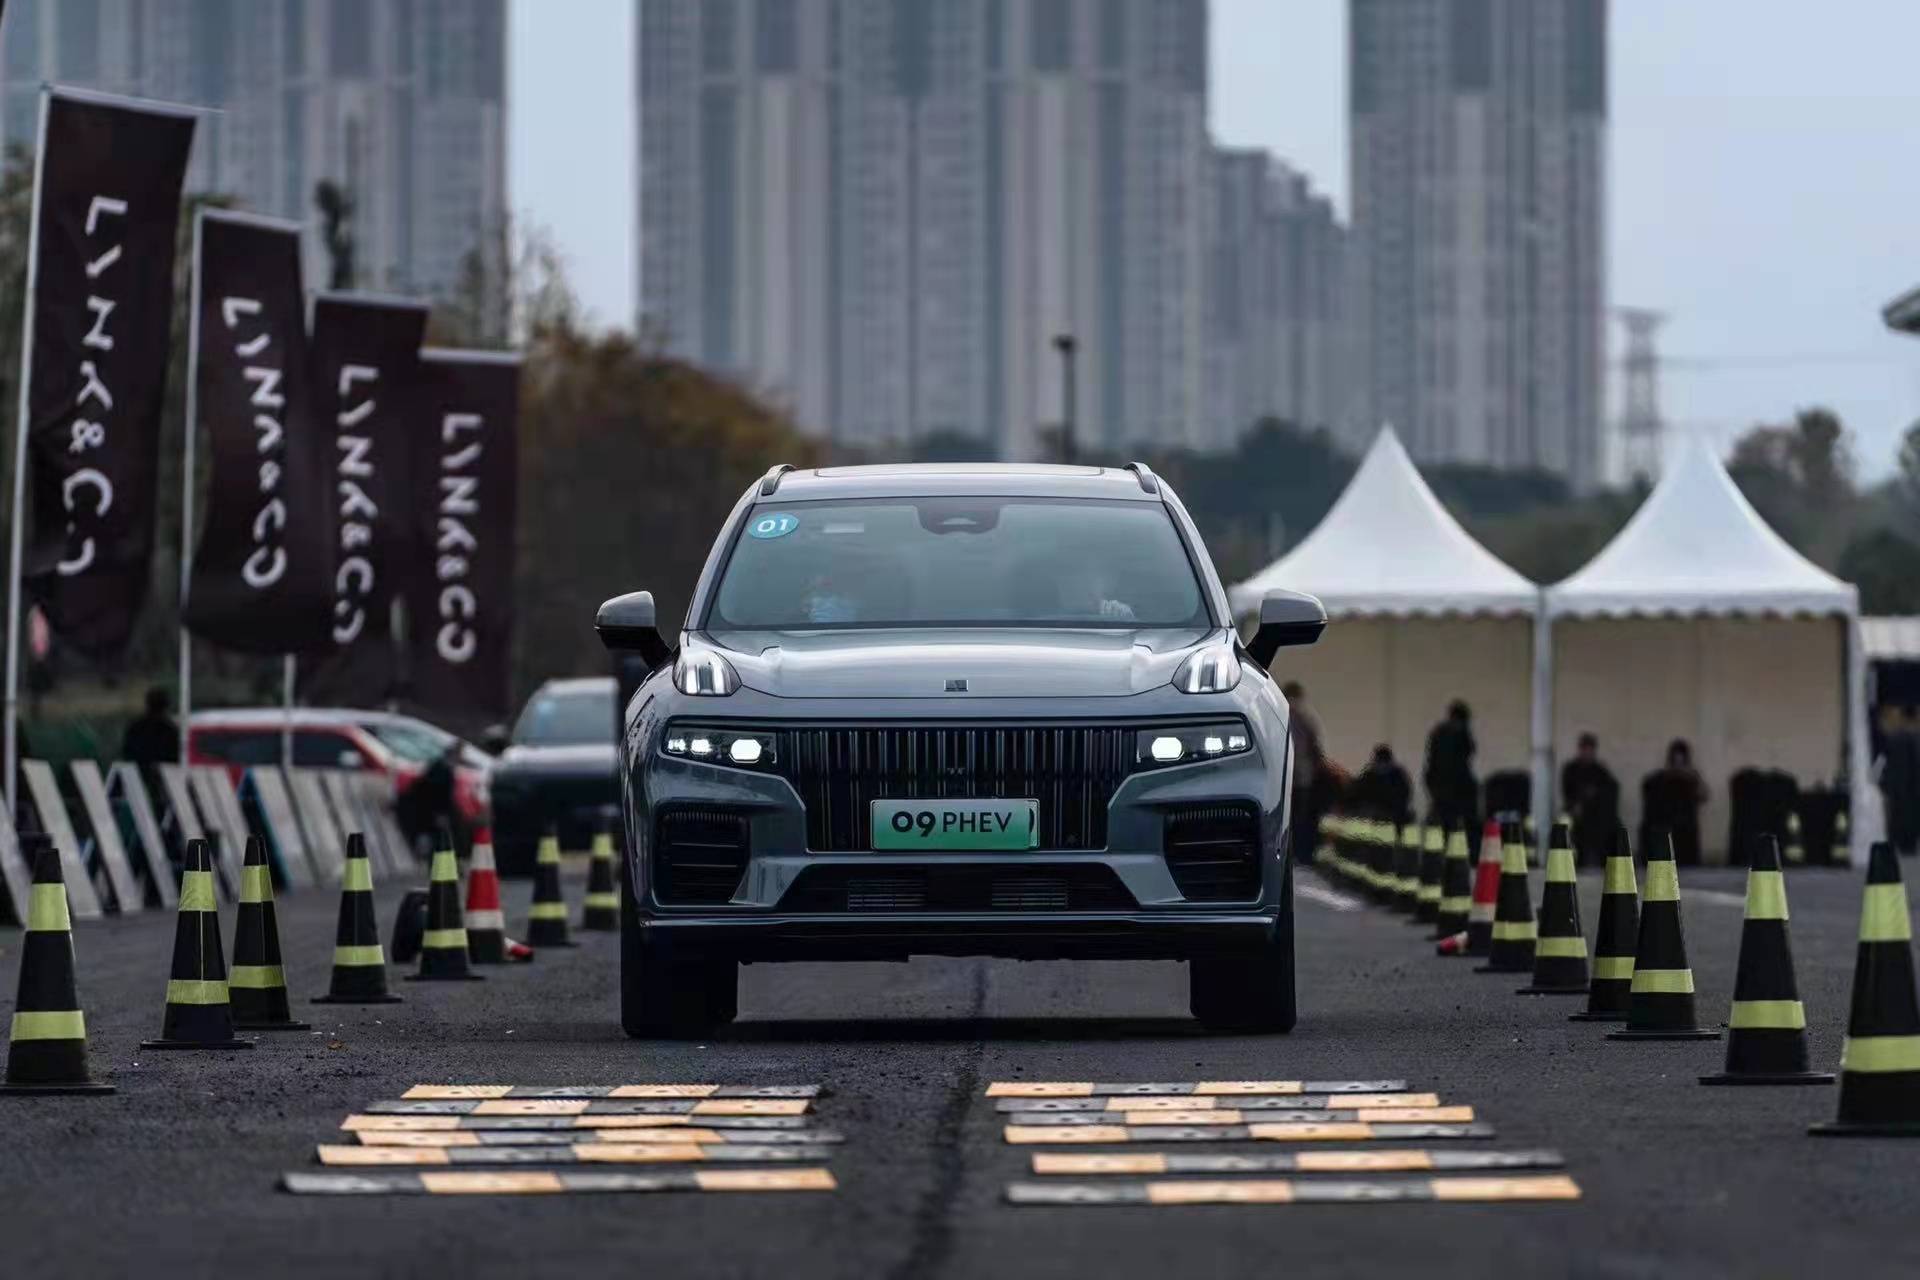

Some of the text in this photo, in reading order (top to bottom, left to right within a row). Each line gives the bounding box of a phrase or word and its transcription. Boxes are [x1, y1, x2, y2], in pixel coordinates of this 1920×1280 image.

[757, 519, 788, 532] 01
[891, 811, 936, 837] 09
[942, 811, 1012, 833] PHEV
